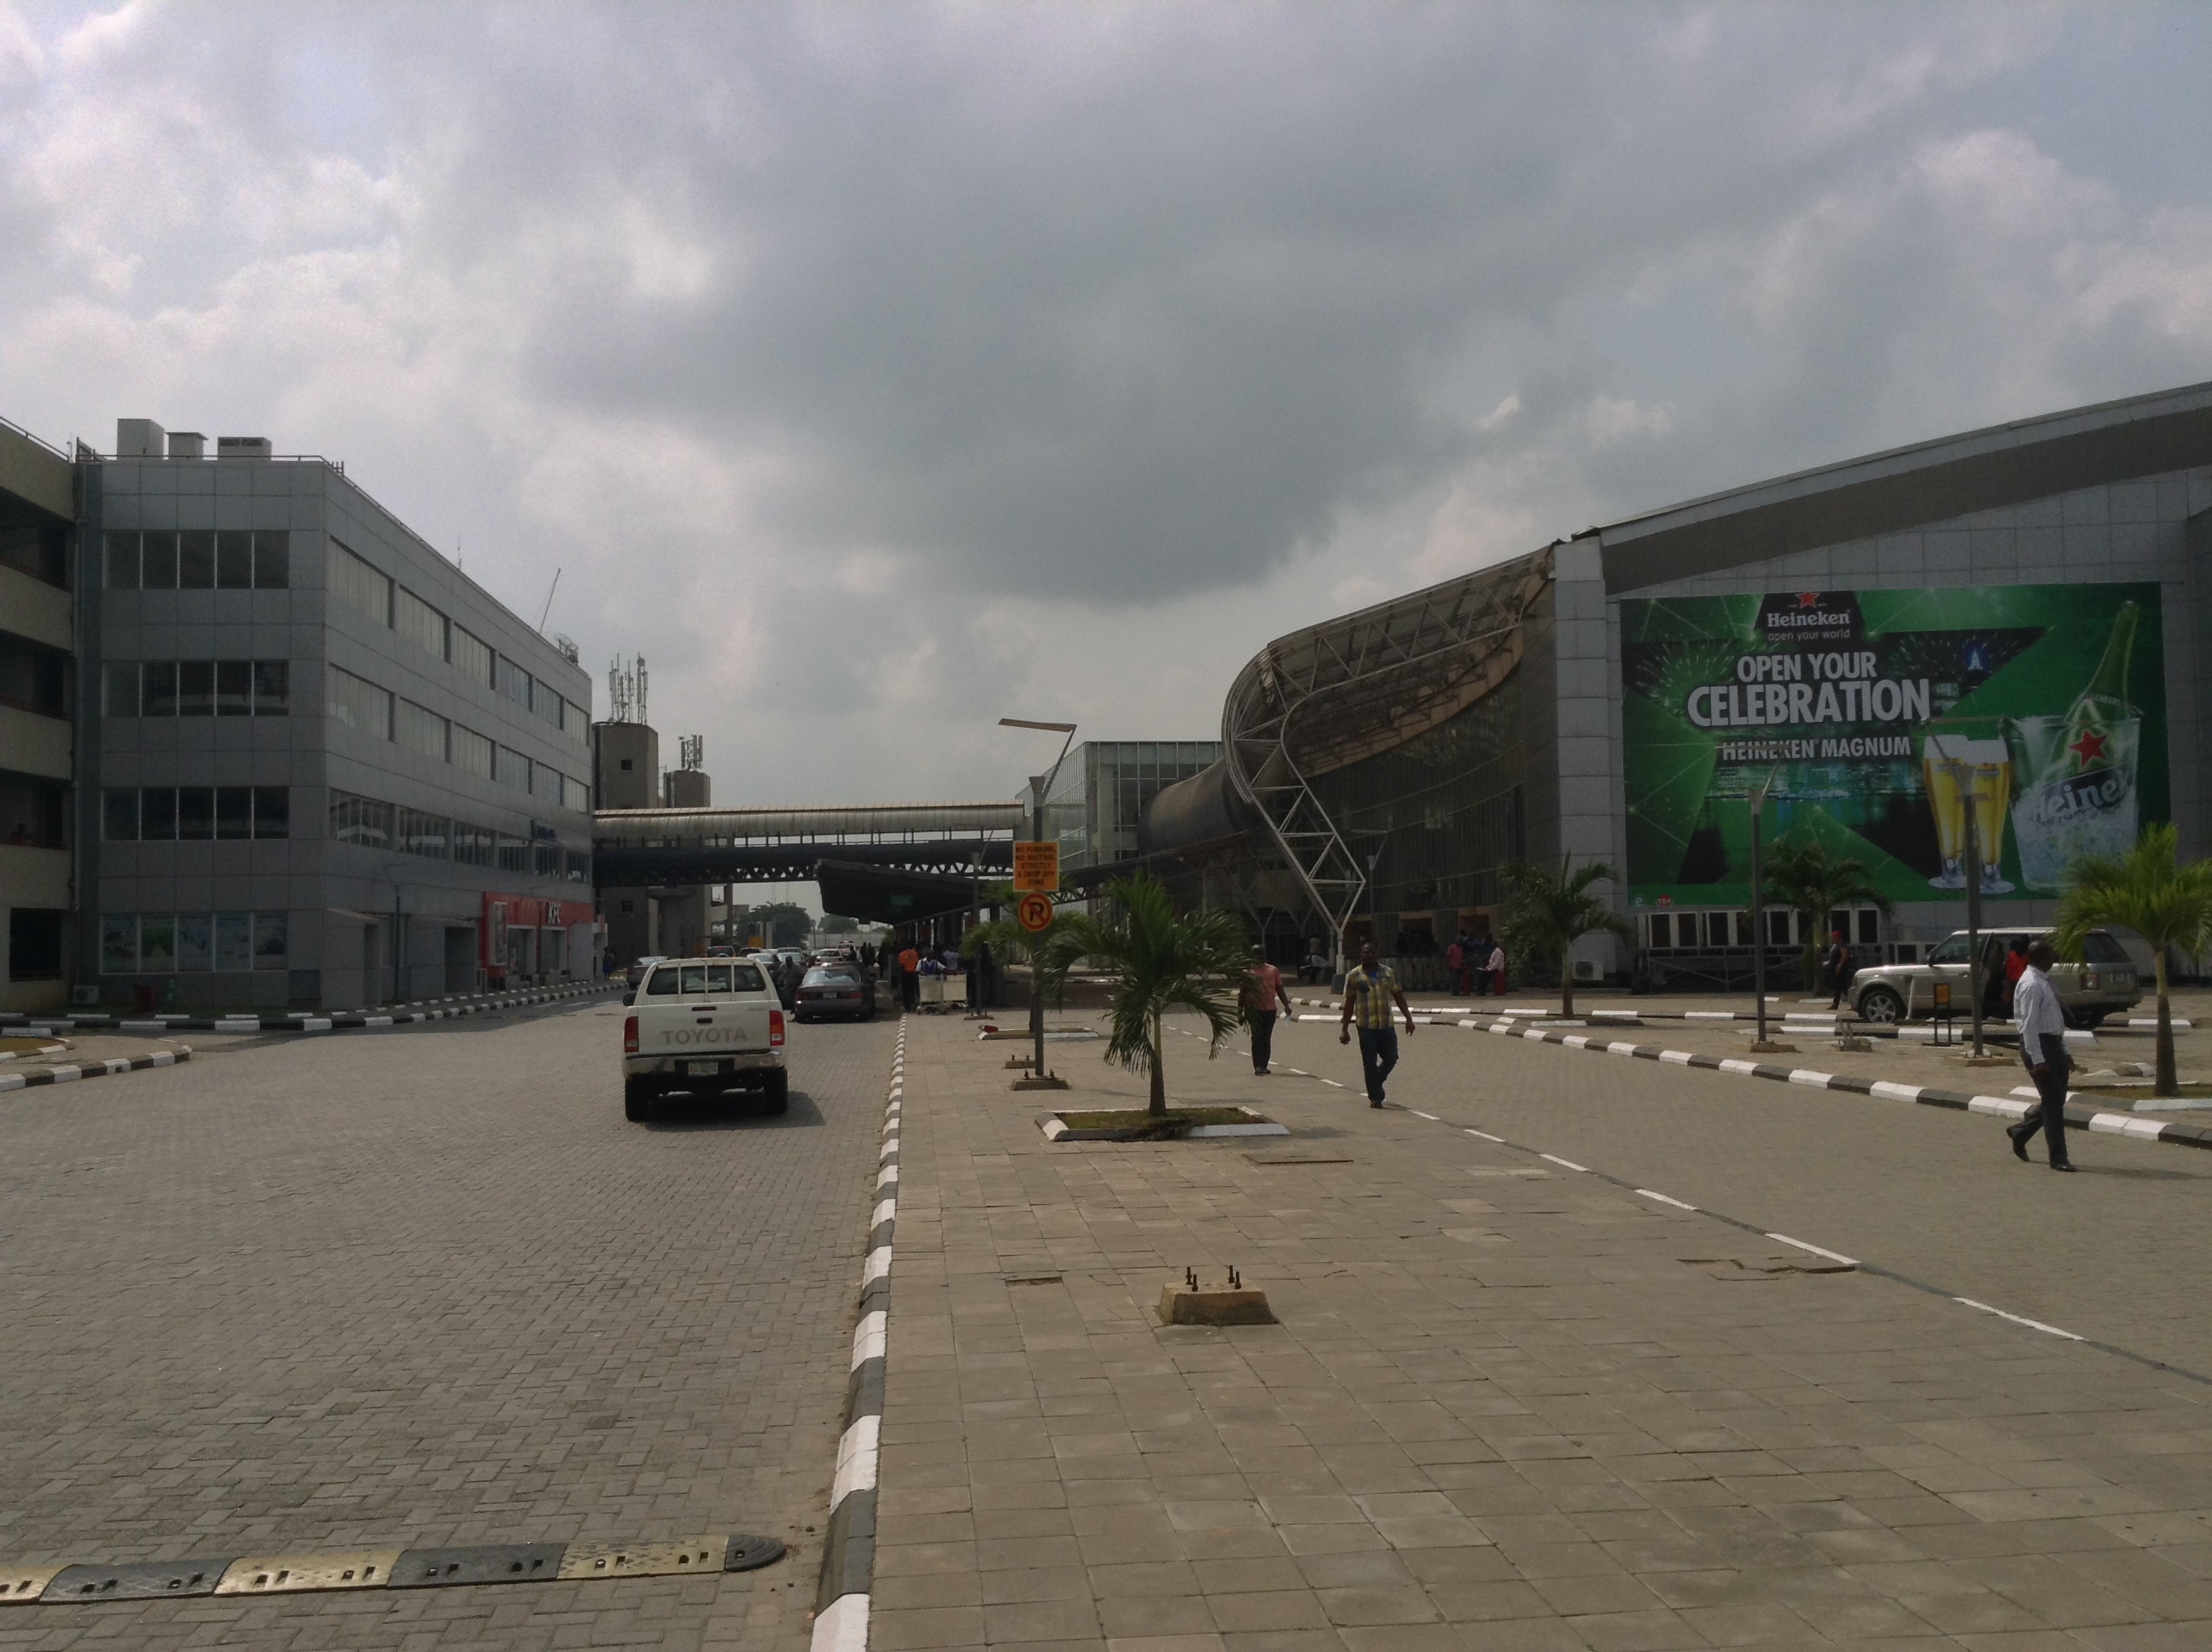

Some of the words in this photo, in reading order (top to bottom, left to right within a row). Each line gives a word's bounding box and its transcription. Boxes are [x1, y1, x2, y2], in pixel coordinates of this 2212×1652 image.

[1767, 611, 1851, 628] Heineken
[1767, 631, 1794, 642] open
[1796, 631, 1819, 642] your
[1821, 628, 1850, 638] world
[1737, 654, 1802, 683] OPEN
[1807, 651, 1877, 680] YOUR
[1687, 678, 1930, 727] CELEBRATION
[1821, 736, 1912, 759] MAGNUM
[548, 902, 561, 924] KFC
[662, 1027, 748, 1045] TOYOTA
